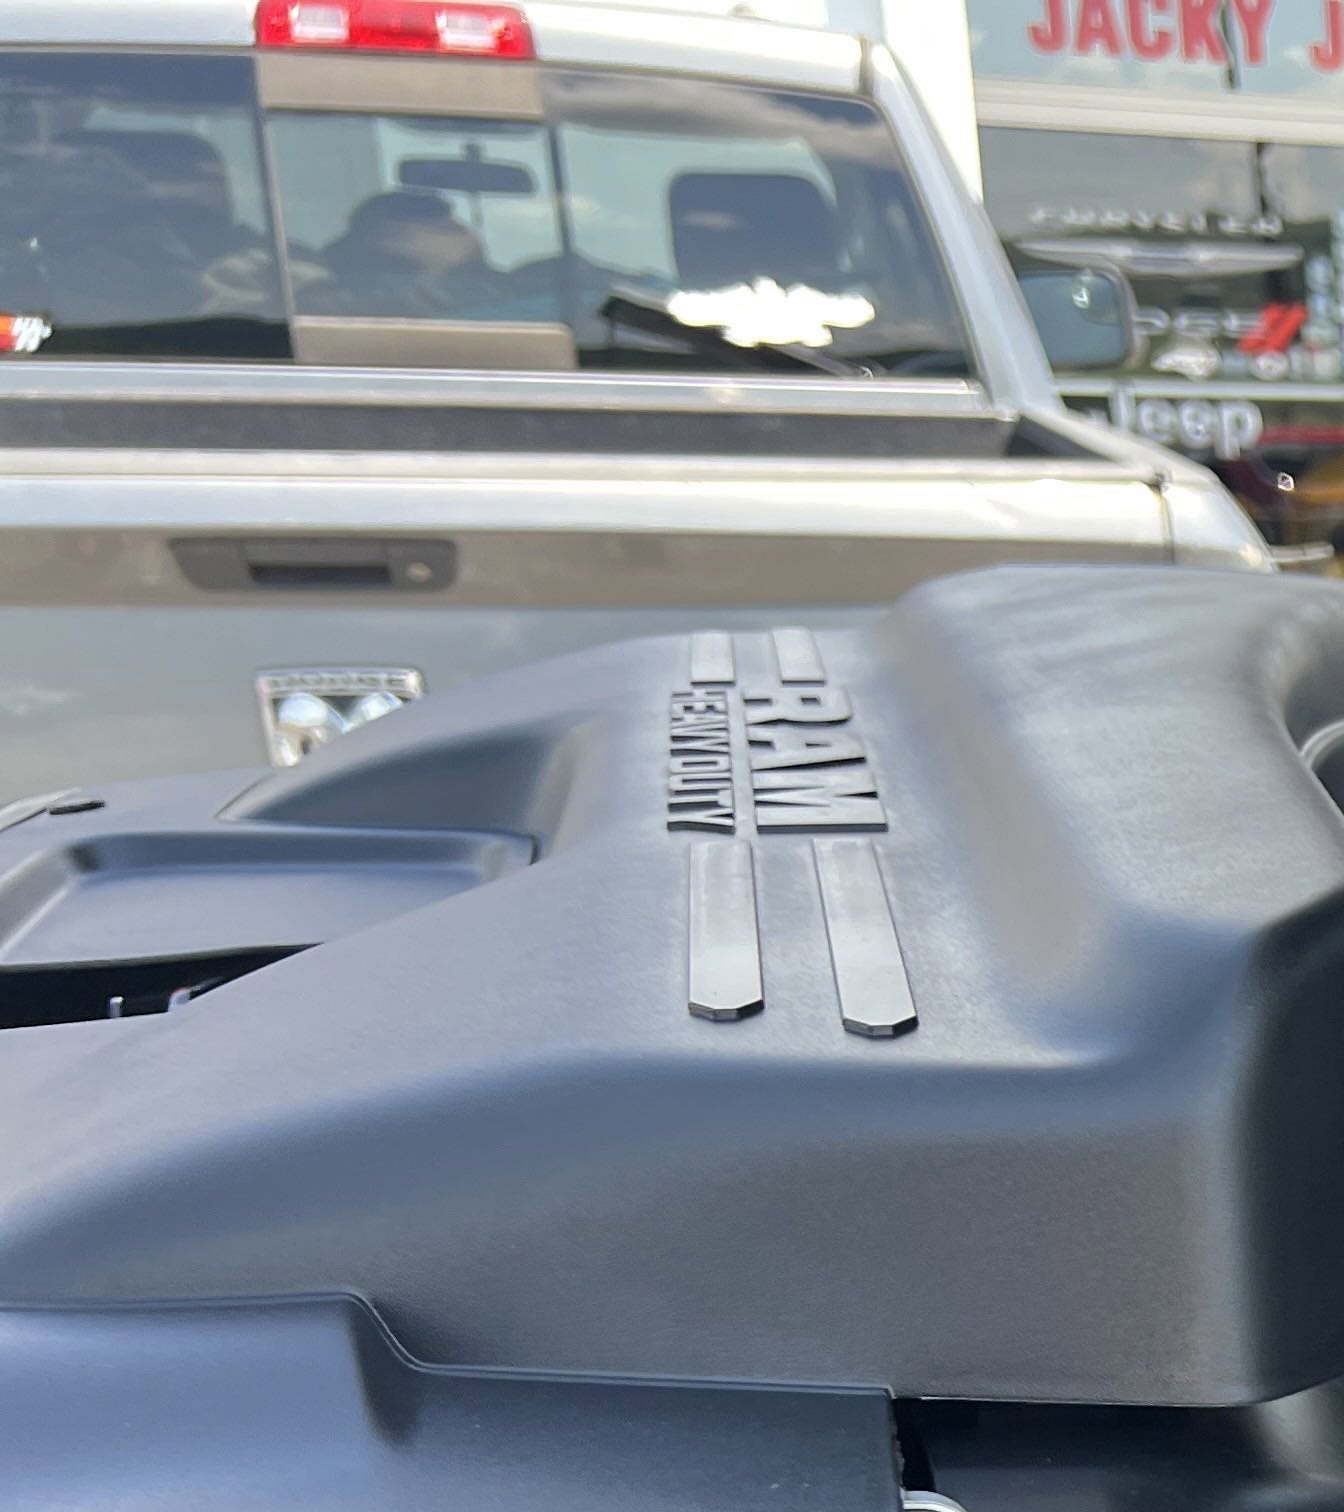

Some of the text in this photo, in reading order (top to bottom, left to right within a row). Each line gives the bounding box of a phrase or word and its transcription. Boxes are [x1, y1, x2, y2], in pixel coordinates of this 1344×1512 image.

[1029, 0, 1272, 64] JACKY
[667, 755, 735, 829] DUTY
[743, 686, 888, 831] RAM
